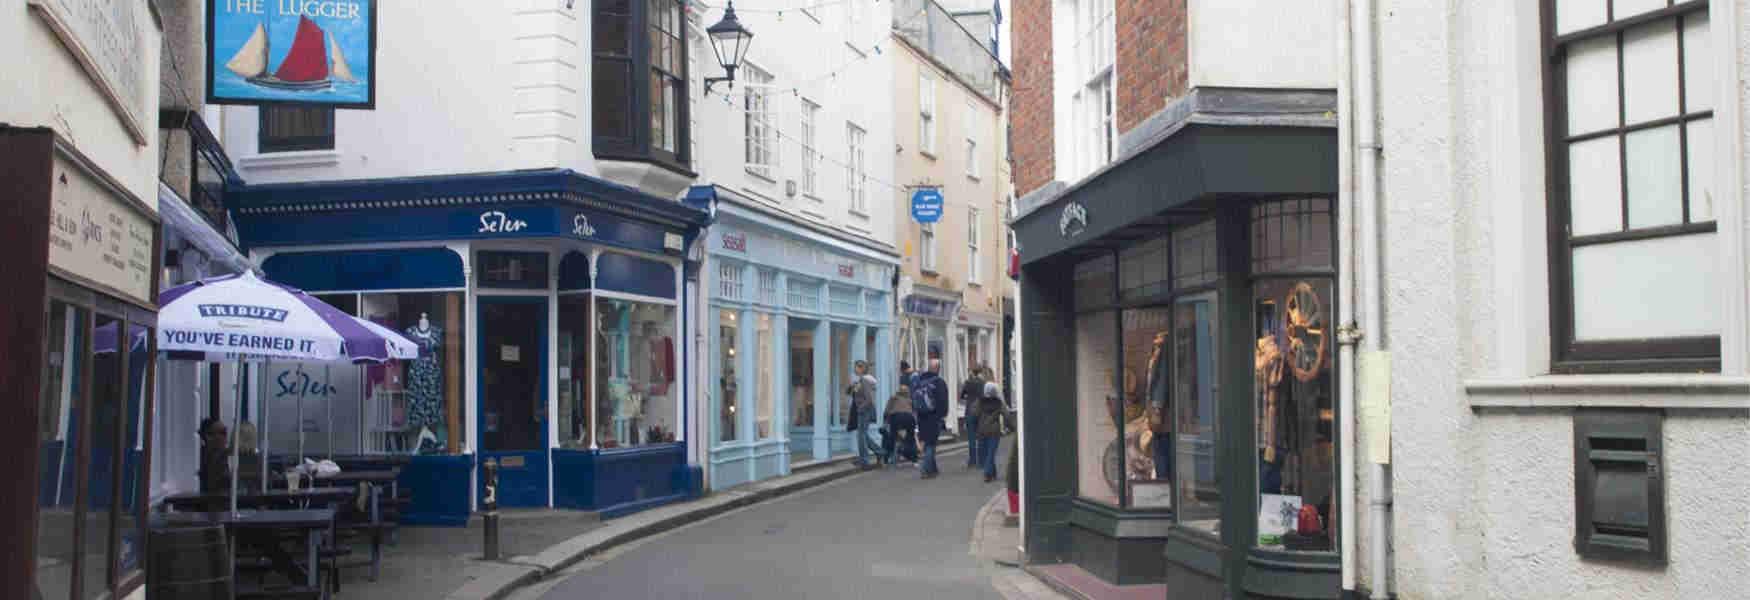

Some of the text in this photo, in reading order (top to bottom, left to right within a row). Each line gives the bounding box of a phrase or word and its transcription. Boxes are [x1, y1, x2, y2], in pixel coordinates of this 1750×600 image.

[225, 0, 361, 18] THE LUGGER
[200, 304, 286, 322] TRIBUTE
[164, 329, 225, 346] YOU'VE
[228, 333, 295, 351] EARNED
